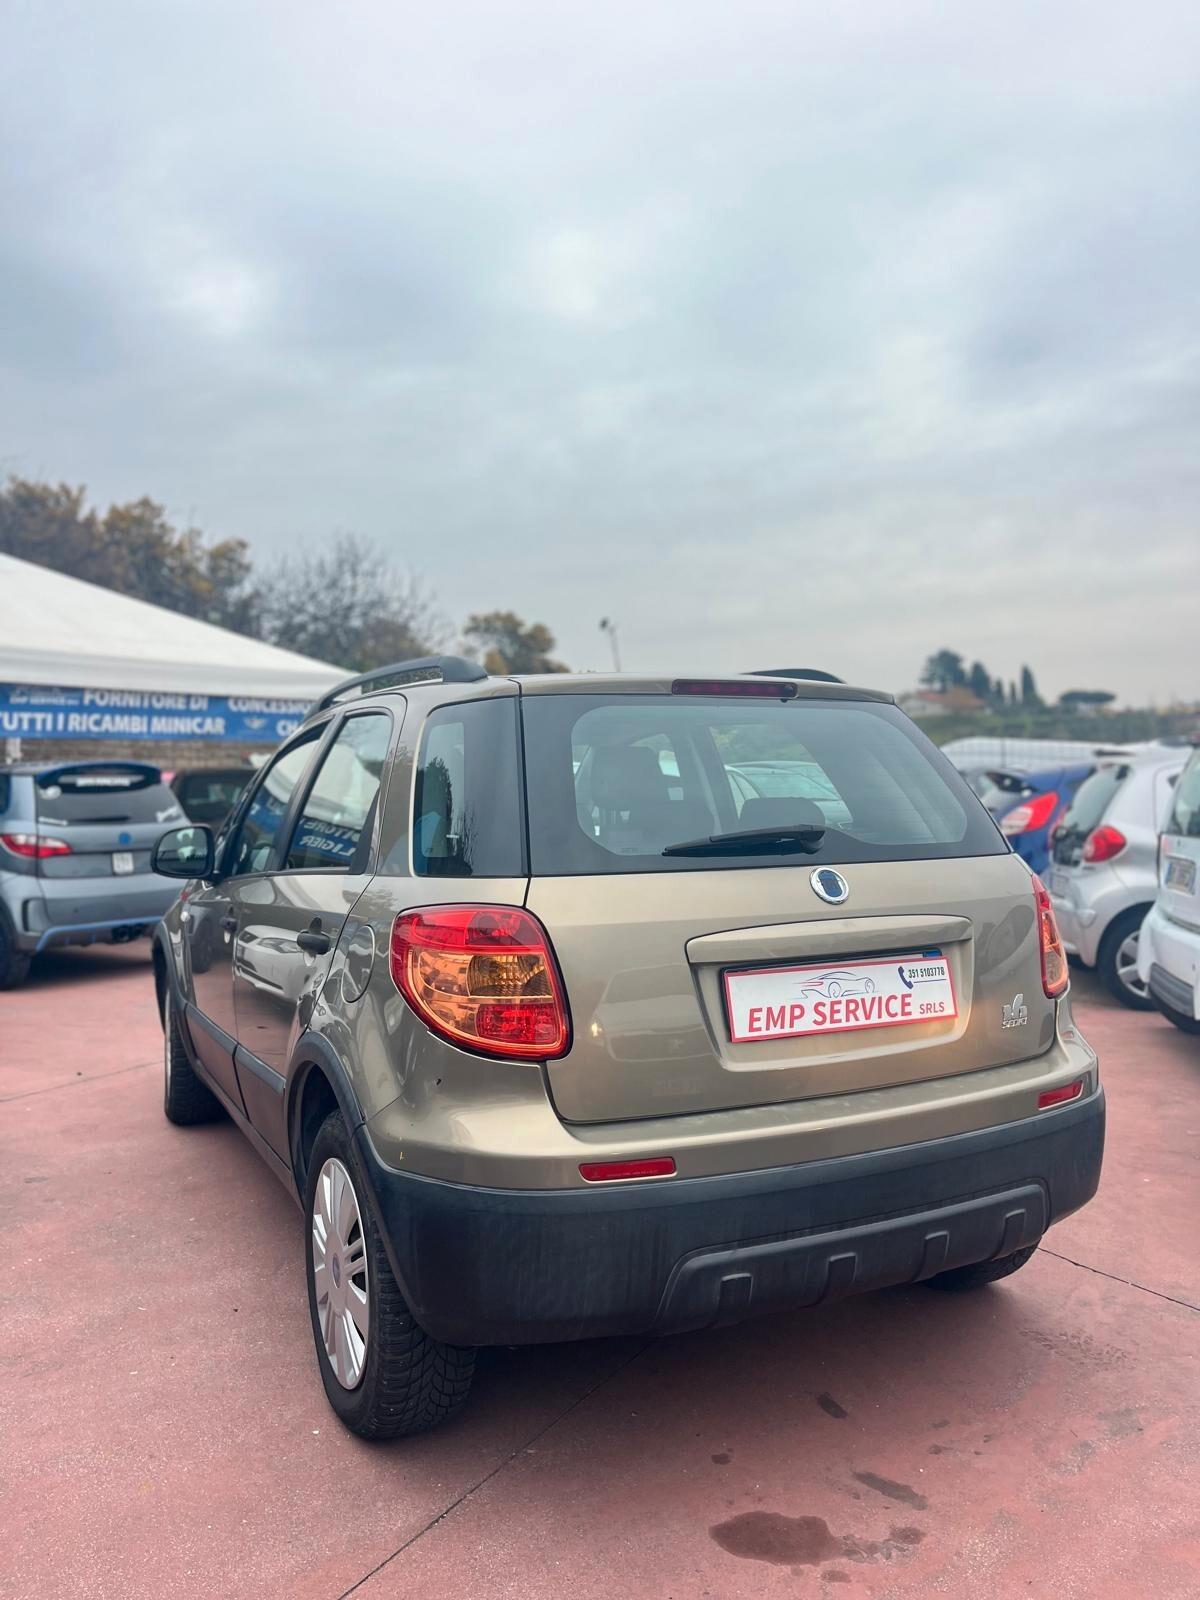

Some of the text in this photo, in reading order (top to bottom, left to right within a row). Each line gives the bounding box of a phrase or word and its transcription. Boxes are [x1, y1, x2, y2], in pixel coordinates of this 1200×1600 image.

[83, 689, 187, 710] FORNITORE
[189, 695, 209, 711] DI
[0, 710, 226, 736] UTTI I RICAMBI MINICAR
[908, 966, 945, 979] 351 5103778
[748, 993, 945, 1033] EMP SERVICE SRLS
